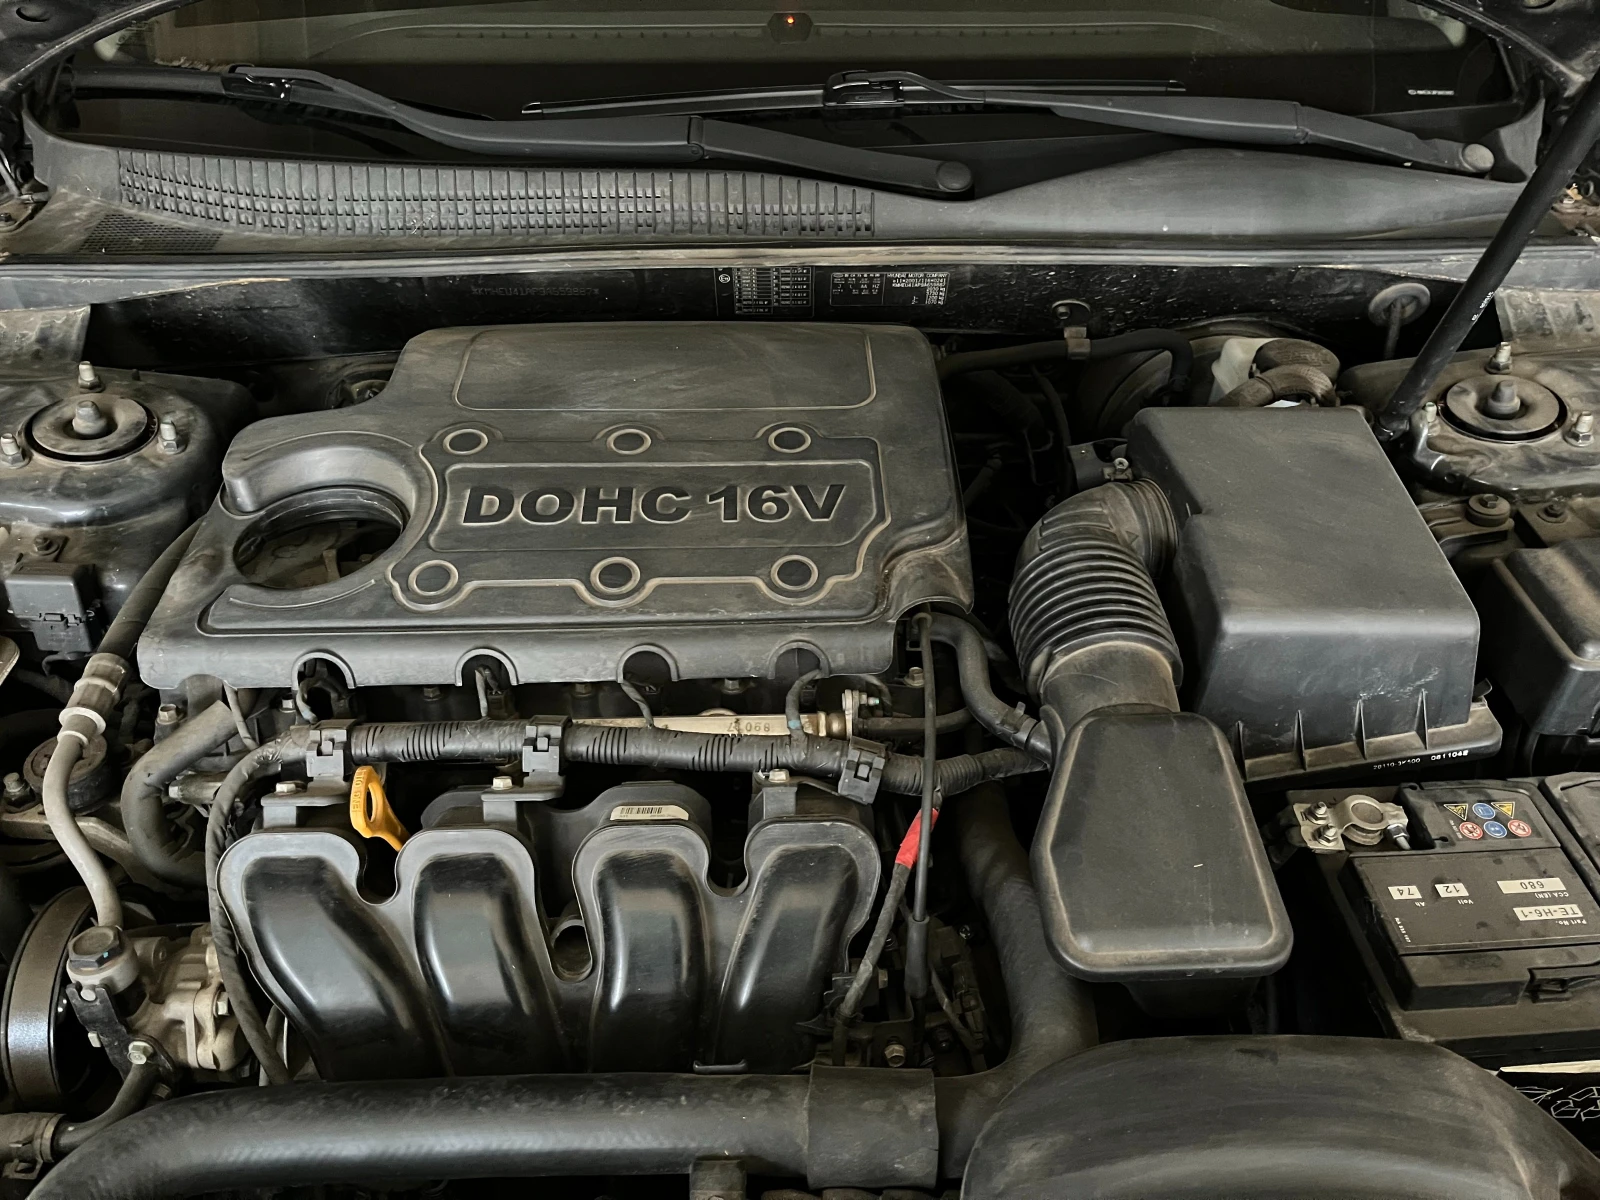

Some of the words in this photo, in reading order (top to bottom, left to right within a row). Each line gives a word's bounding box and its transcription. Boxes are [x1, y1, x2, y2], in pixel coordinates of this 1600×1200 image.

[463, 486, 691, 524] DOHC
[708, 484, 845, 523] 16V
[1443, 884, 1460, 893] 12
[1520, 880, 1545, 890] 680
[1397, 887, 1414, 896] 74
[1520, 906, 1579, 918] TE-H6-1
